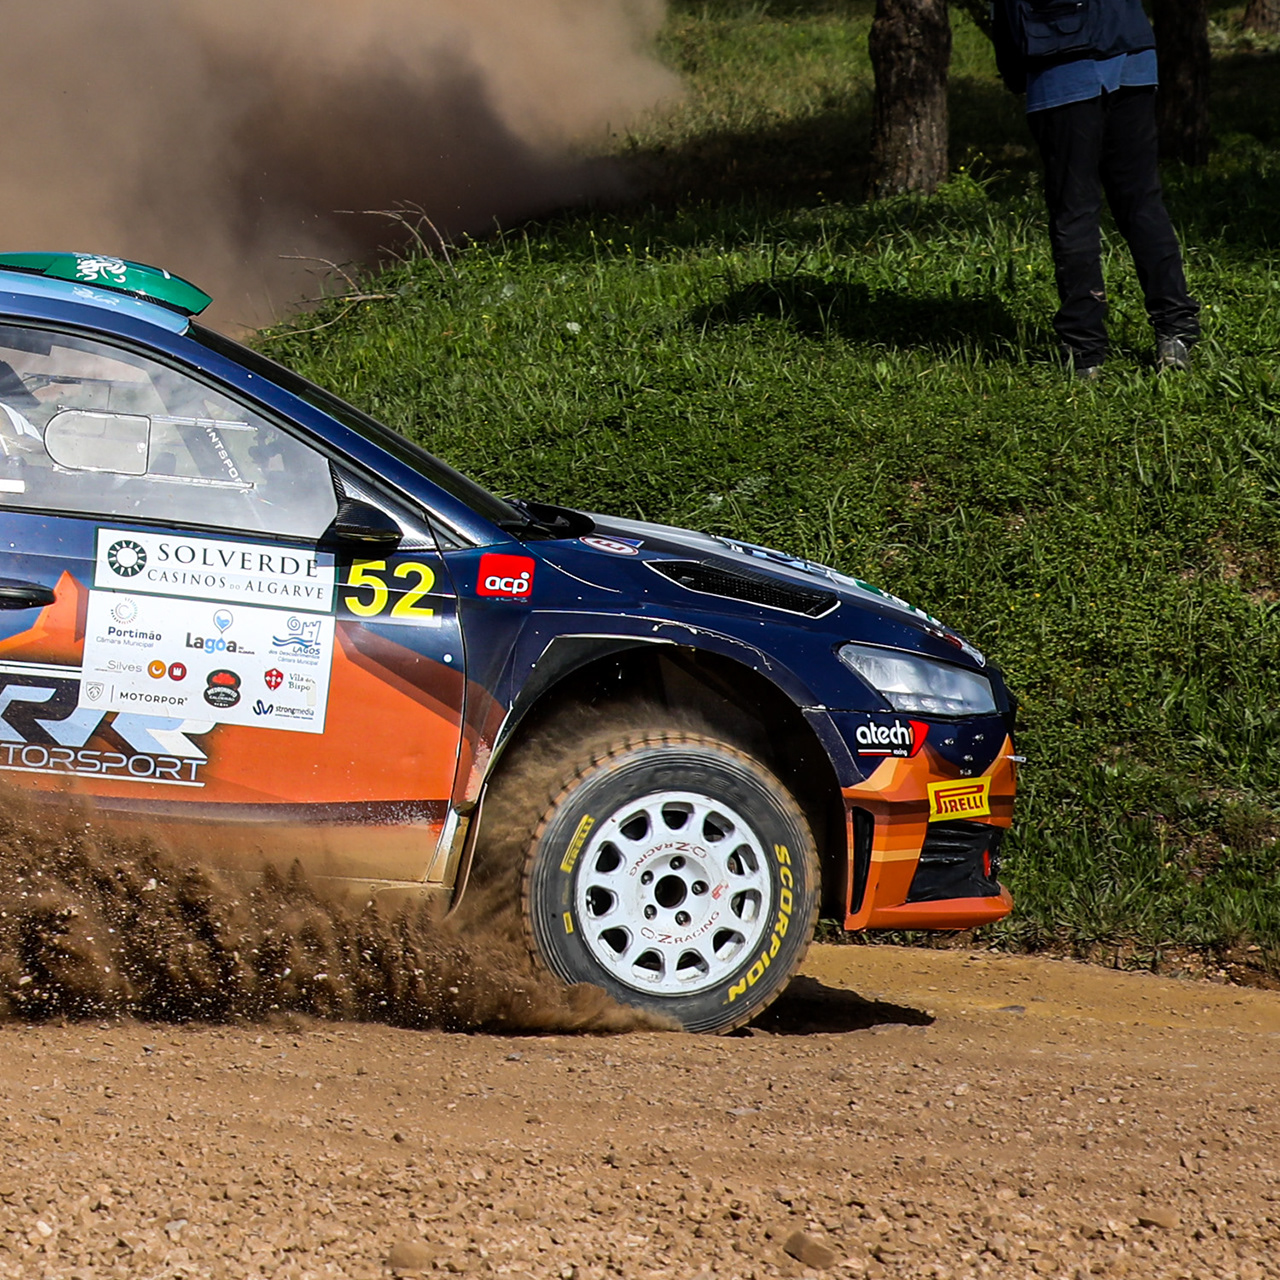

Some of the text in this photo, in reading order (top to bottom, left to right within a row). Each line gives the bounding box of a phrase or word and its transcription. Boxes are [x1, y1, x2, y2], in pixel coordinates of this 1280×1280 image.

[157, 543, 319, 578] SOLVERDE
[147, 569, 226, 589] CASINOS
[244, 579, 324, 600] ALGARVE
[344, 558, 435, 618] 52
[485, 572, 531, 595] acp
[108, 626, 162, 641] Portimão
[185, 632, 238, 654] Lagoa
[292, 646, 321, 656] LAGOS
[107, 660, 143, 672] Silves
[288, 681, 311, 692] Bispo
[856, 720, 910, 745] atech
[934, 784, 984, 814] PIRELLI
[674, 911, 720, 944] RACING
[726, 843, 795, 1003] SCORPION
